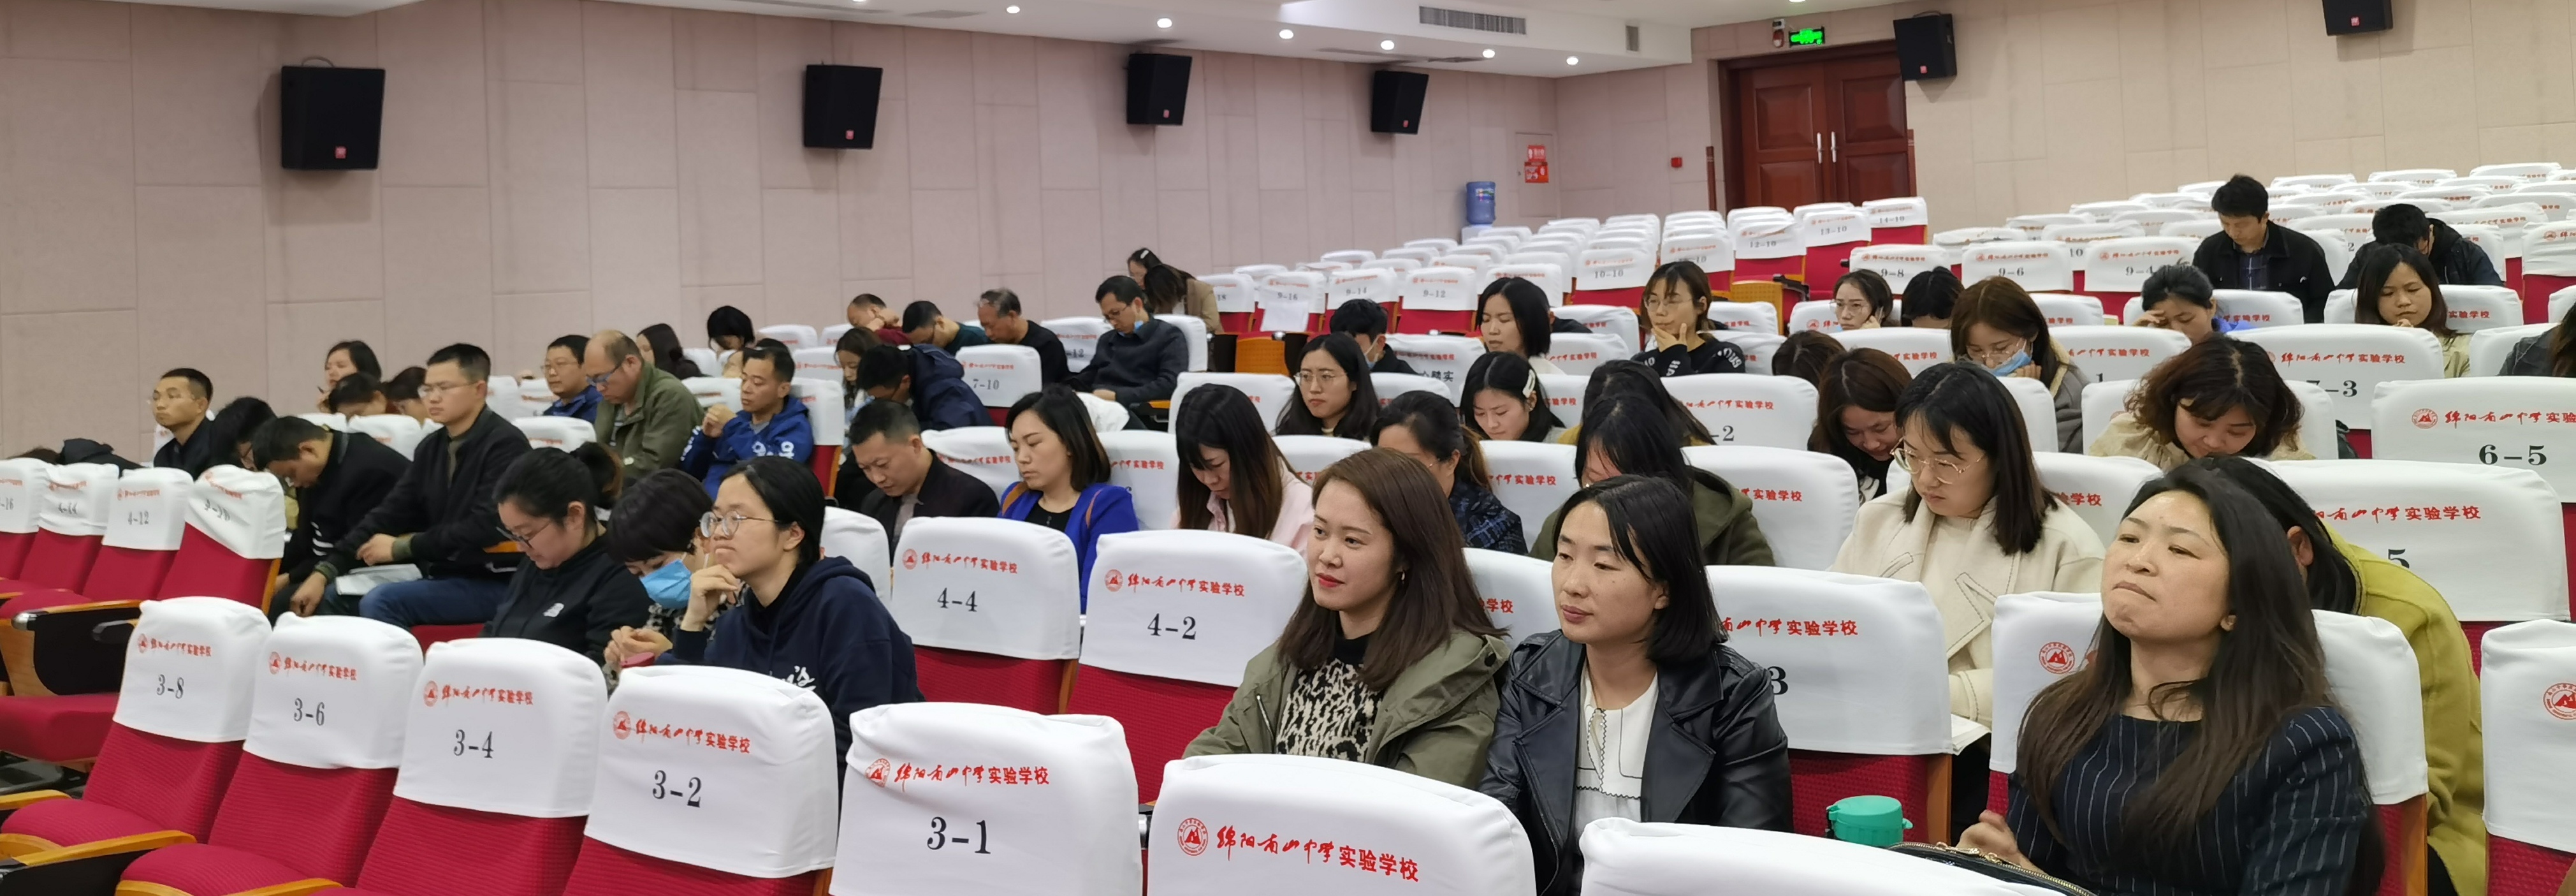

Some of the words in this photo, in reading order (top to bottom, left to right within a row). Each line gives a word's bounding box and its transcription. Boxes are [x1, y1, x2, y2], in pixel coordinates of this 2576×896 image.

[1880, 269, 1903, 278] 9-8
[1998, 268, 2024, 277] 9-6
[2126, 267, 2153, 275] 9-4
[2280, 352, 2405, 367] 绵阳南山中学实验学校
[973, 379, 999, 390] 7-10
[2478, 444, 2547, 466] 6-5
[127, 511, 149, 525] 4-12
[921, 552, 1018, 574] 绵阳南山中学实验学校
[1127, 574, 1245, 598] 绵阳南山中学实验学校
[938, 587, 977, 612] 4-4
[1147, 613, 1196, 640] 4-2
[157, 674, 185, 699] 3-8
[440, 684, 533, 707] 绵阳南山中学实验学校
[294, 697, 325, 726] 3-6
[453, 729, 494, 759] 3-4
[635, 719, 751, 754] 绵阳南山中学实验学校
[652, 770, 701, 808] 3-2
[894, 763, 1051, 792] 绵阳南山中学实验学校
[927, 816, 991, 855] 3-1
[1216, 825, 1420, 883] 绵阳南山中学实验学校
